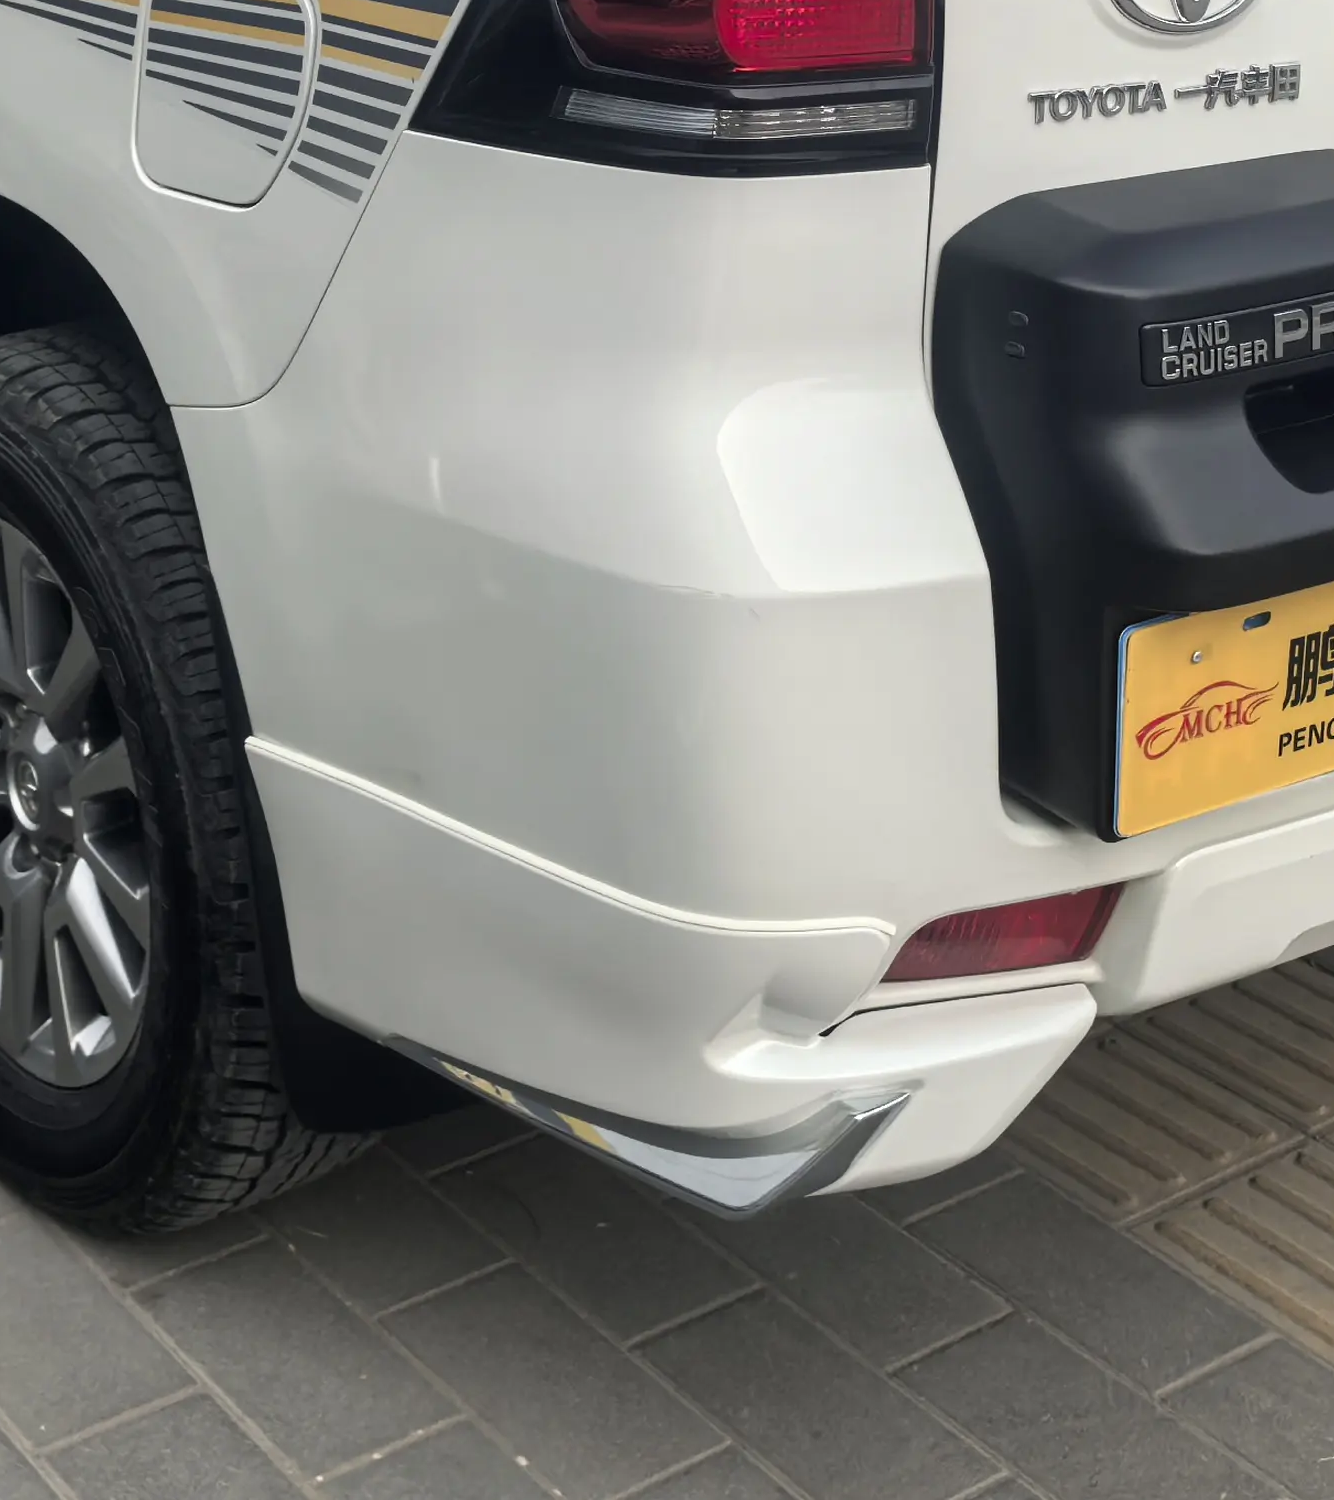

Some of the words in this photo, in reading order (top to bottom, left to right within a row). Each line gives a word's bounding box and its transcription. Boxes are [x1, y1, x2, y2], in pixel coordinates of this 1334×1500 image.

[1027, 80, 1167, 124] TOYOTA
[1161, 320, 1230, 353] LAND
[1161, 339, 1268, 380] CRUISER
